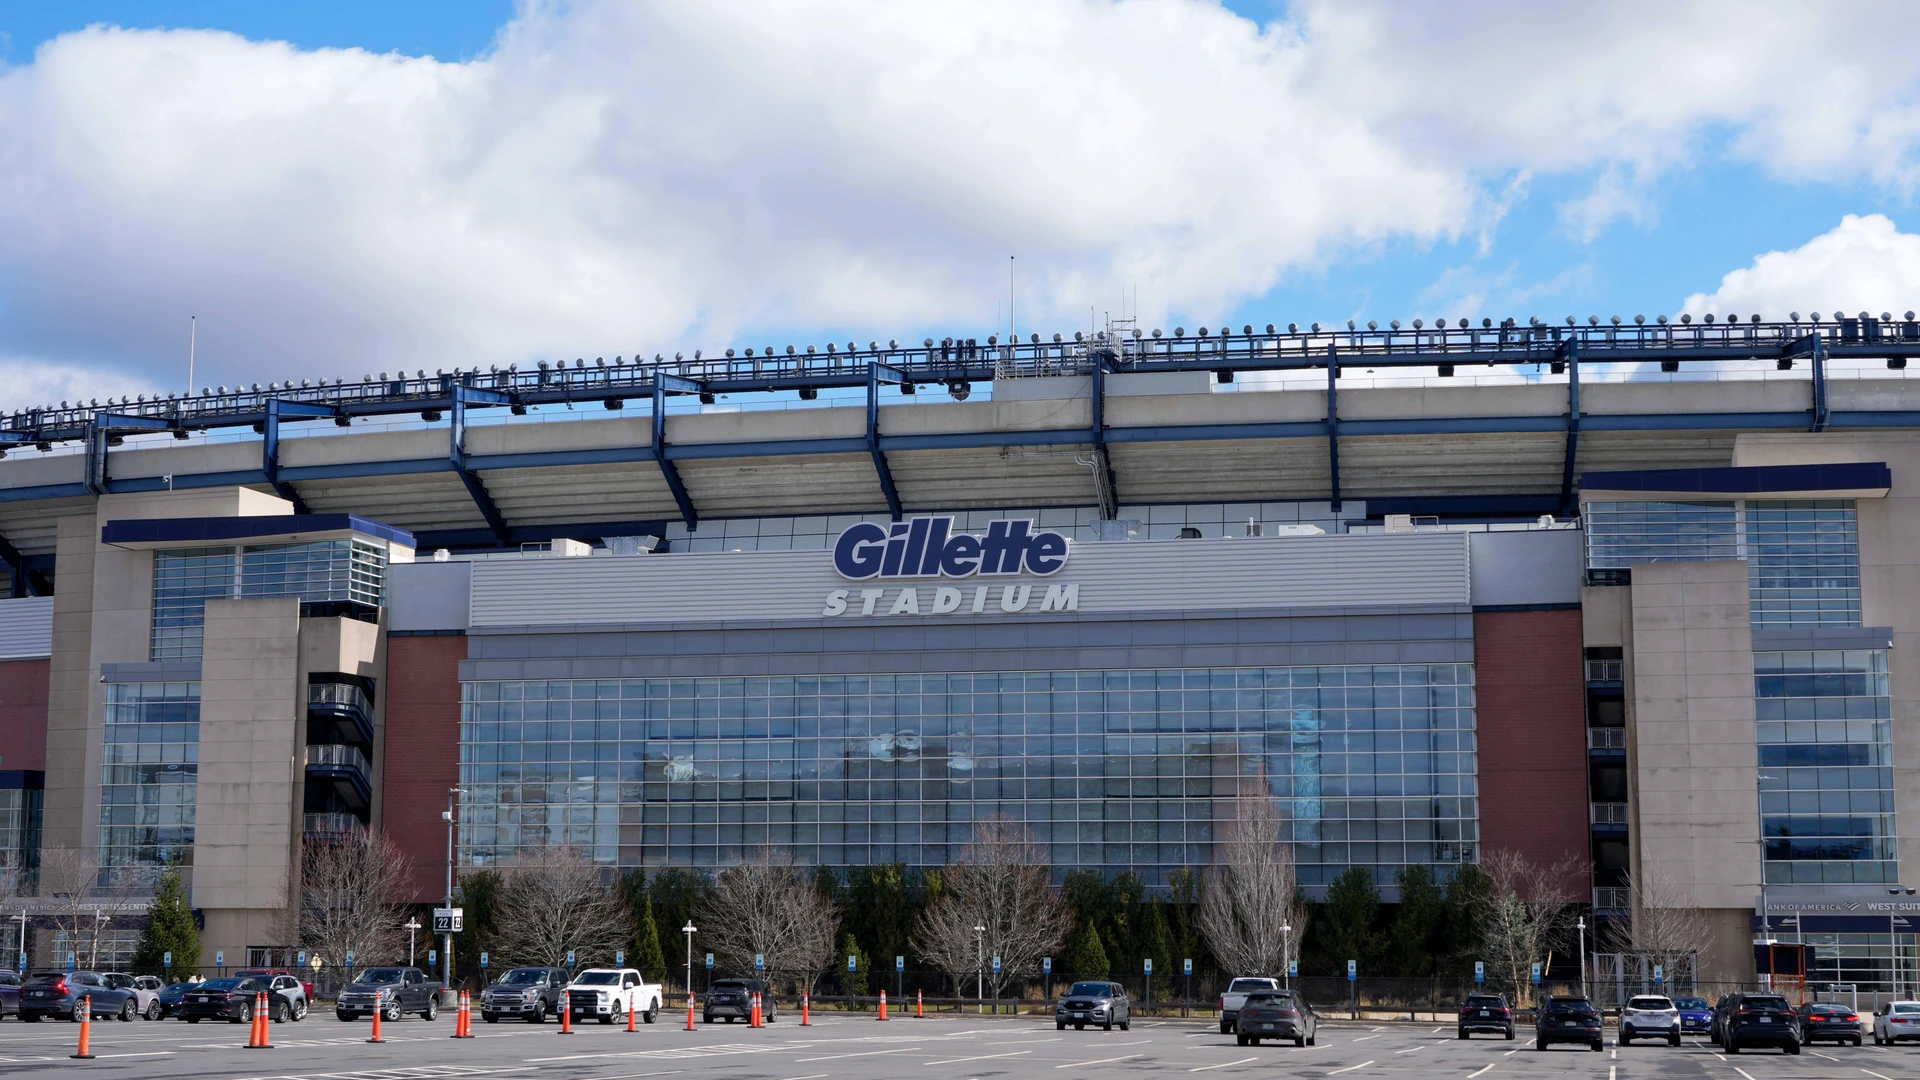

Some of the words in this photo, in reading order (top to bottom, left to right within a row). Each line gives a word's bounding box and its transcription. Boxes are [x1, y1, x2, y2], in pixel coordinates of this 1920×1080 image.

[833, 515, 1070, 580] Gillette
[822, 584, 1079, 616] STADIUM
[1867, 902, 1897, 911] WEST
[438, 918, 448, 928] 22
[455, 917, 460, 928] 22
